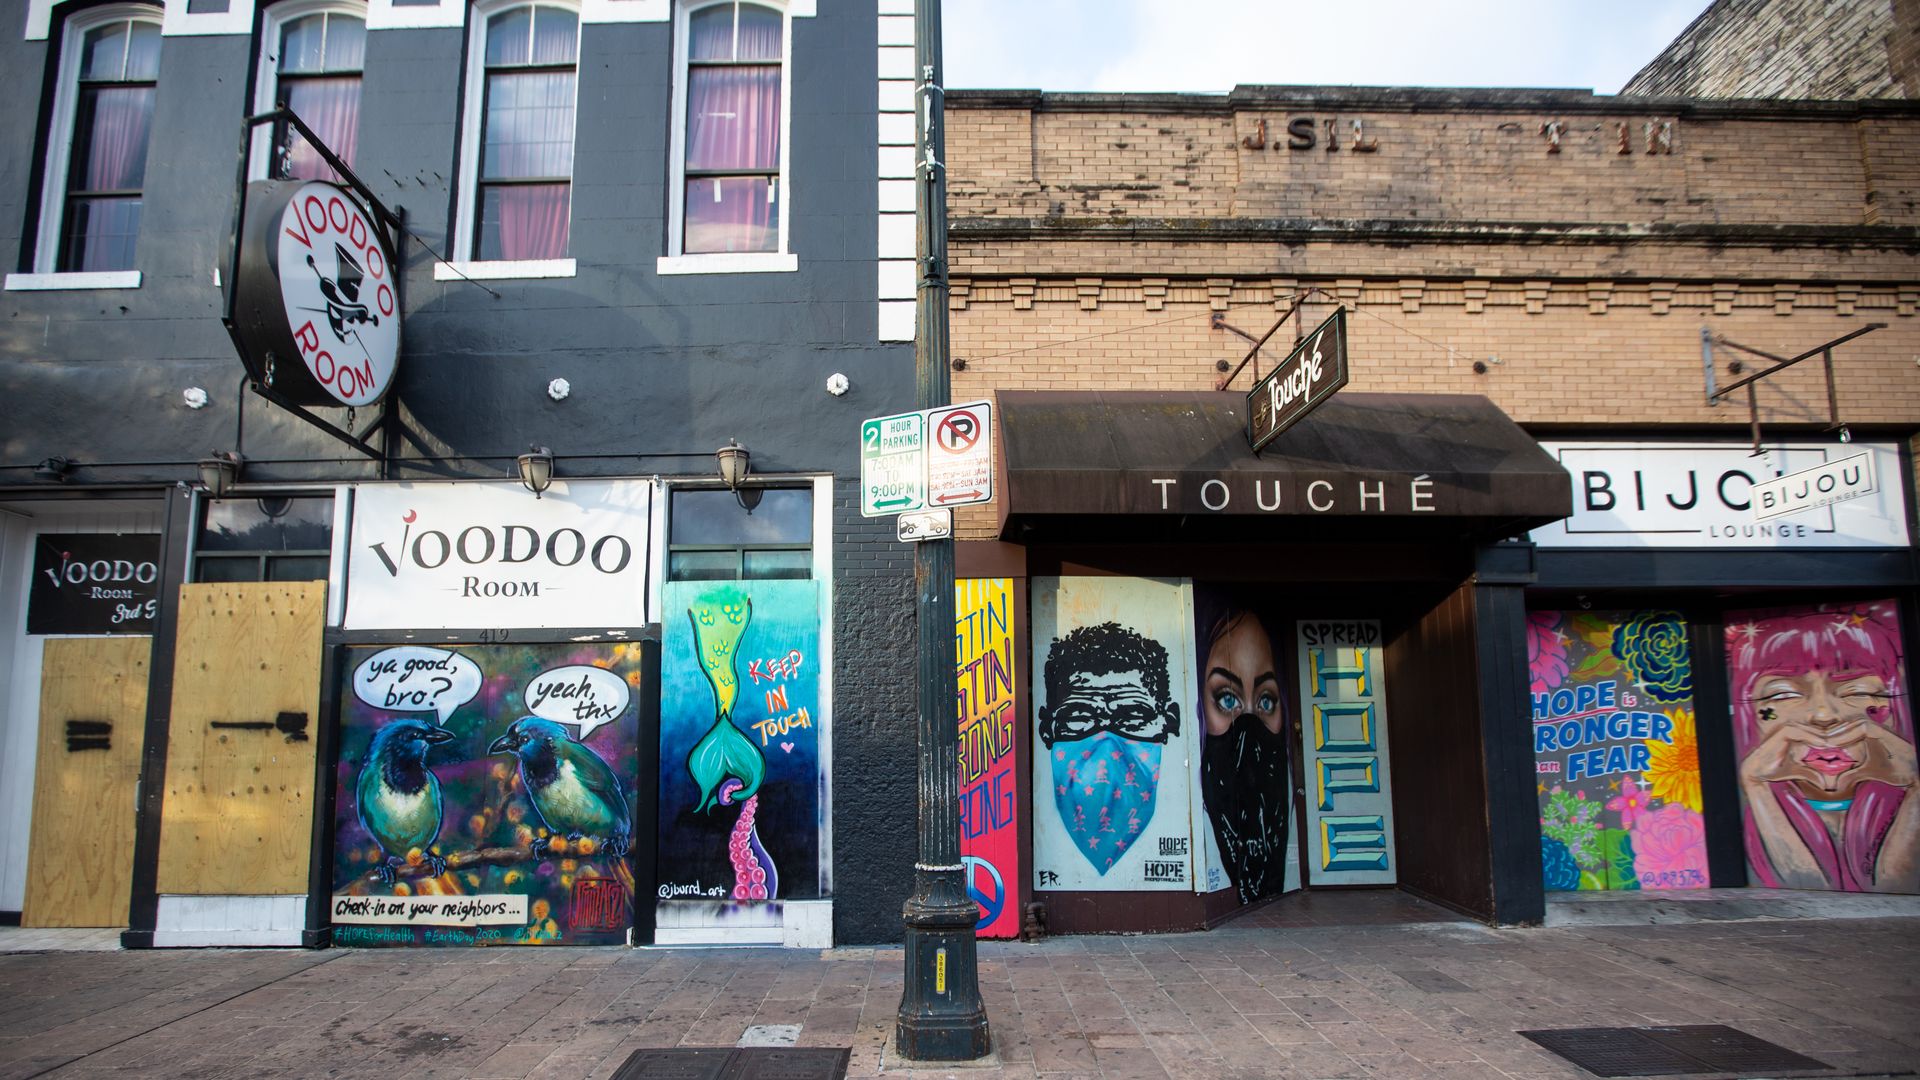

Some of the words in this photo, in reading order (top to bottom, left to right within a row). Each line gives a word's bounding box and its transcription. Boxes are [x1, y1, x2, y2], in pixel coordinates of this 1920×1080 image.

[285, 195, 394, 317] VOODOO
[294, 320, 375, 398] ROOM
[1267, 330, 1324, 431] Touché
[865, 426, 879, 452] 2
[890, 420, 912, 432] HOUR
[883, 434, 918, 449] PARKING
[871, 482, 915, 498] 9:00PM
[886, 470, 900, 483] TO
[1151, 473, 1436, 512] TOUCHÉ
[1583, 469, 1784, 513] BIJO
[1762, 465, 1861, 509] BIJOU
[1710, 524, 1807, 539] LOUNGE
[369, 524, 632, 578] VOODOO
[44, 558, 158, 588] VOODO
[111, 603, 142, 624] 3rd
[480, 628, 510, 643] 419
[1302, 622, 1378, 646] SPREAD
[367, 658, 398, 684] ya
[398, 651, 458, 684] good,
[749, 649, 802, 685] KEEP
[384, 677, 453, 708] bro?
[531, 674, 596, 710] yeah,
[765, 684, 789, 714] IN
[1531, 680, 1617, 720] HOPE
[1622, 691, 1637, 708] is
[572, 700, 617, 720] thx
[751, 706, 812, 747] TOUCH
[957, 700, 1013, 788] RONG
[1534, 710, 1675, 753] RONGER
[1308, 646, 1389, 872] HOPE
[1535, 761, 1560, 773] an
[1566, 743, 1652, 782] FEAR
[959, 769, 1014, 840] RONG
[1158, 836, 1188, 850] HOPE
[1144, 863, 1185, 877] HOPE
[388, 901, 405, 915] on
[407, 903, 439, 920] your
[476, 926, 501, 940] 2020
